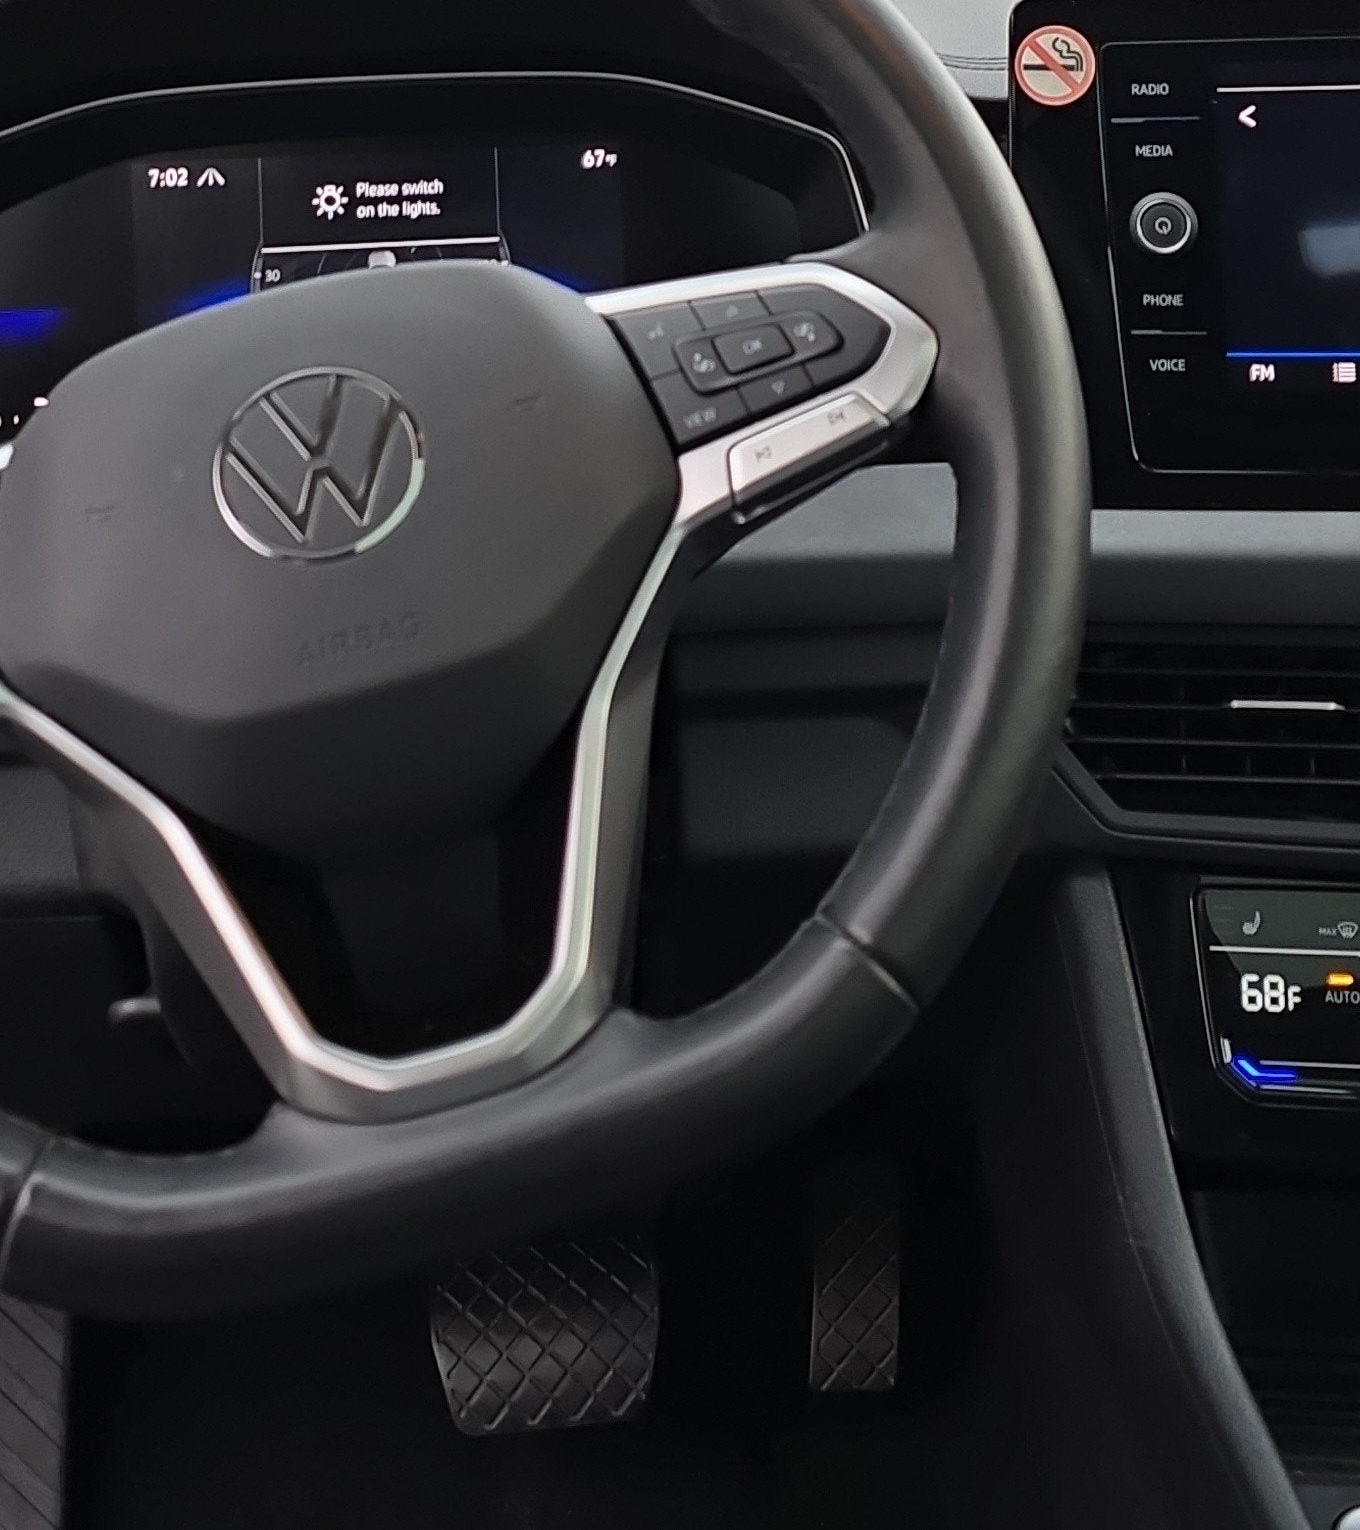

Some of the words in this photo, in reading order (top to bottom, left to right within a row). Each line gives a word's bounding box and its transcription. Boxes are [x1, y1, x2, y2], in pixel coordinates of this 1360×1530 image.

[1131, 82, 1170, 96] RADIO
[1135, 144, 1174, 158] MEDIA
[147, 166, 189, 189] 7:02
[355, 180, 399, 198] Please
[402, 179, 444, 196] switch
[355, 204, 375, 218] on
[378, 201, 400, 217] the
[402, 200, 441, 219] lights.
[1142, 293, 1184, 307] PHONE
[1149, 357, 1186, 372] VOICE
[1249, 363, 1276, 382] FM
[1318, 926, 1338, 937] MAX
[1324, 990, 1360, 1005] AUTO
